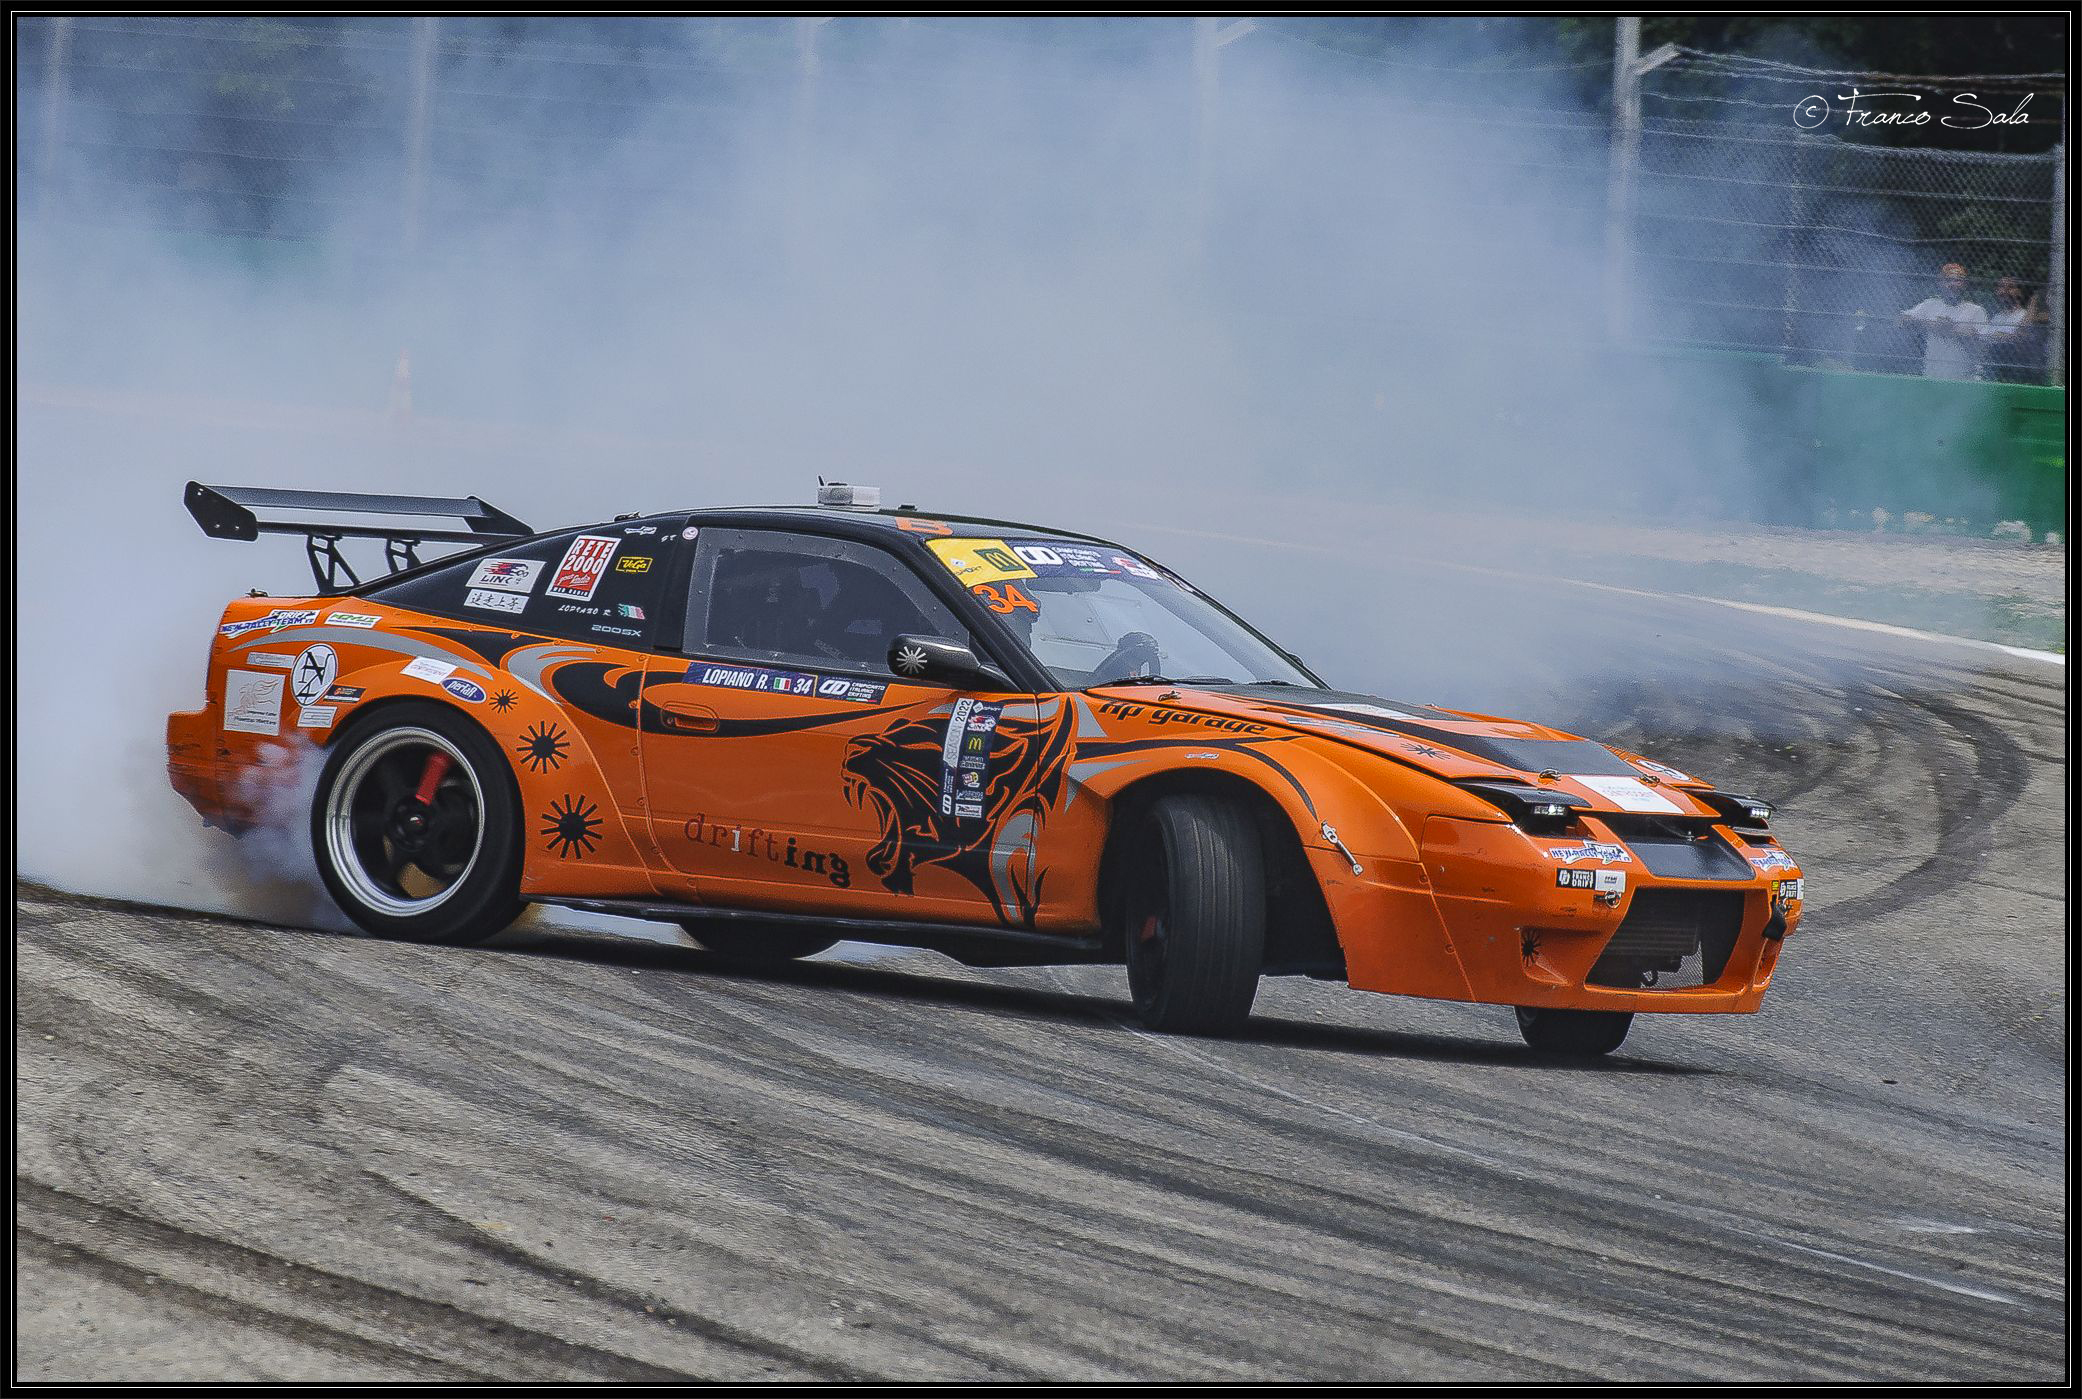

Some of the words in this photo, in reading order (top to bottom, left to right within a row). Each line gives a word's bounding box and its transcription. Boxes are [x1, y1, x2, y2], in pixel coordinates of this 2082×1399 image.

[571, 539, 614, 559] RETE
[562, 554, 605, 575] 2000
[972, 584, 1038, 614] 34
[591, 624, 642, 637] 200SX
[701, 668, 754, 688] LOPIANO
[755, 674, 768, 690] R.
[793, 677, 814, 695] 34
[954, 700, 972, 723] 2022
[1148, 708, 1269, 735] garage
[683, 812, 852, 889] drifting
